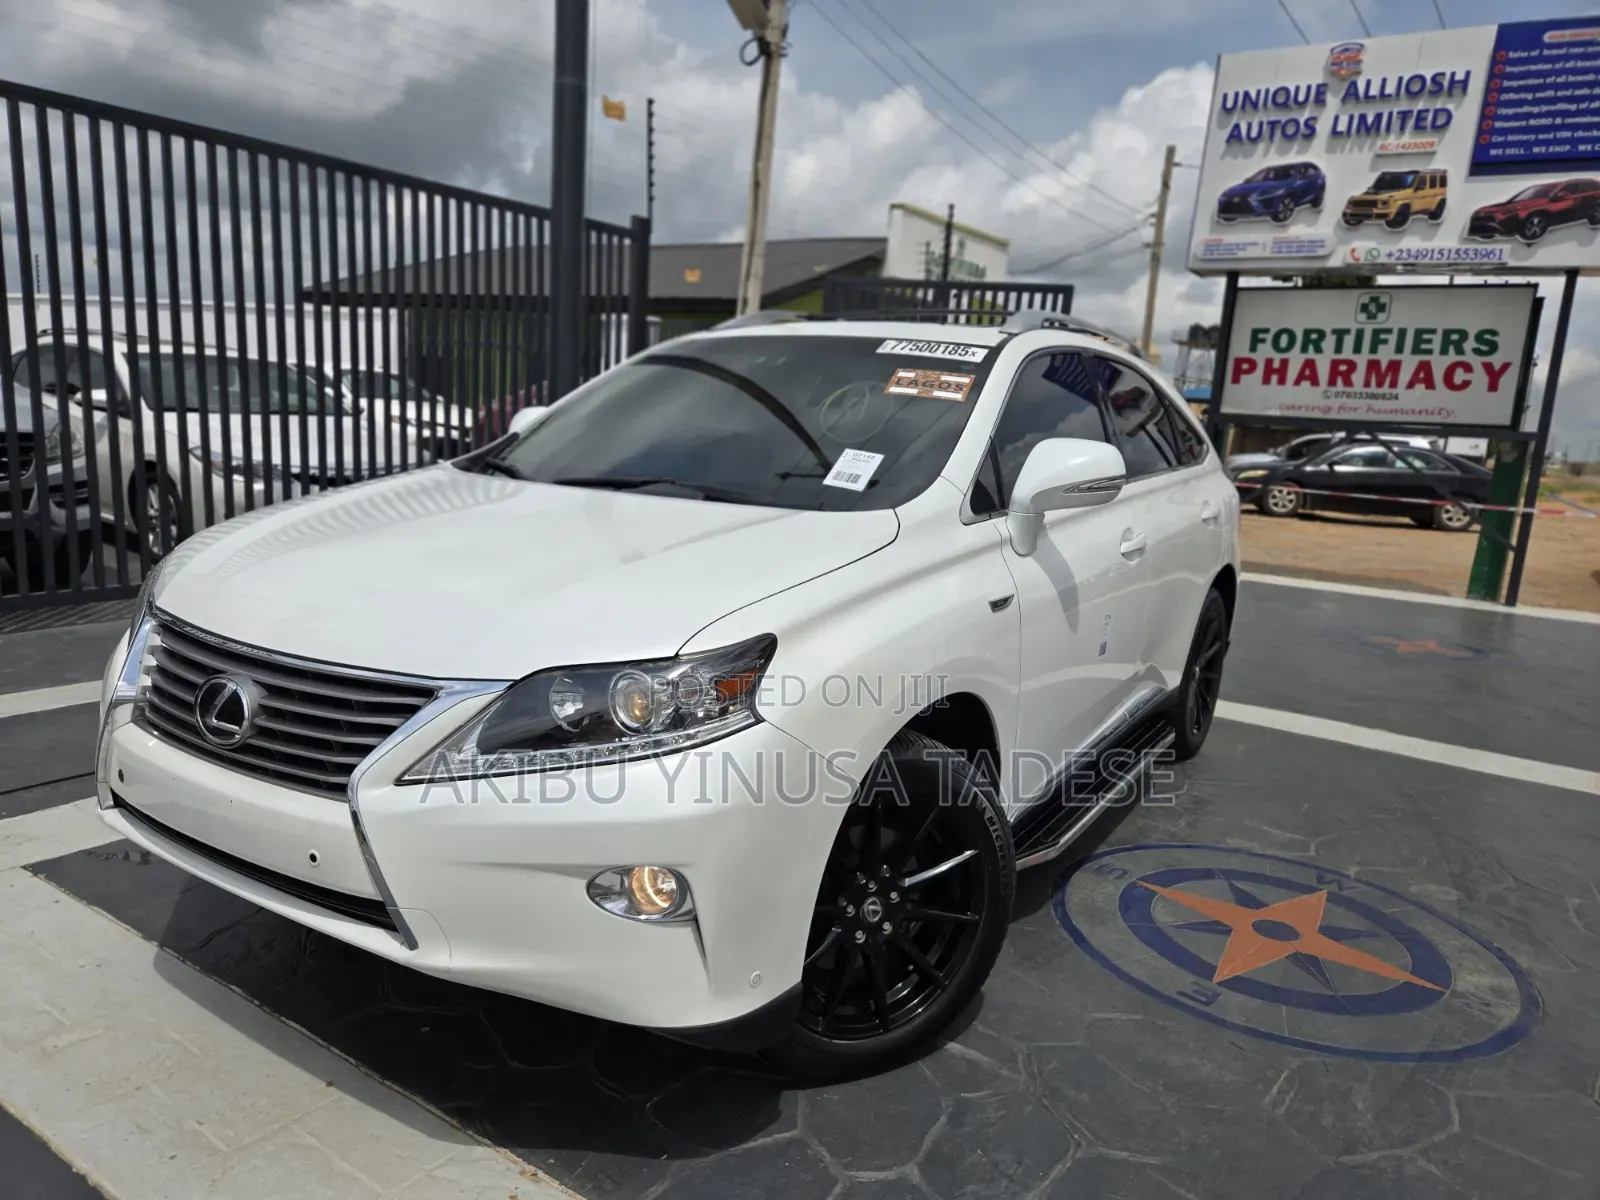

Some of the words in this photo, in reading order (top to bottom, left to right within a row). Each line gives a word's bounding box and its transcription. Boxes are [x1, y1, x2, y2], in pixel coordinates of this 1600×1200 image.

[1221, 82, 1329, 112] UNIQUE
[1340, 69, 1472, 105] ALLIOSH
[1225, 116, 1318, 144] AUTOS
[1331, 107, 1454, 136] LIMITED
[1385, 247, 1505, 261] +2349151553961
[1249, 327, 1500, 356] FORTIFIERS
[895, 377, 966, 392] LAGOS
[1231, 357, 1513, 392] PHARMACY
[1337, 402, 1362, 414] for
